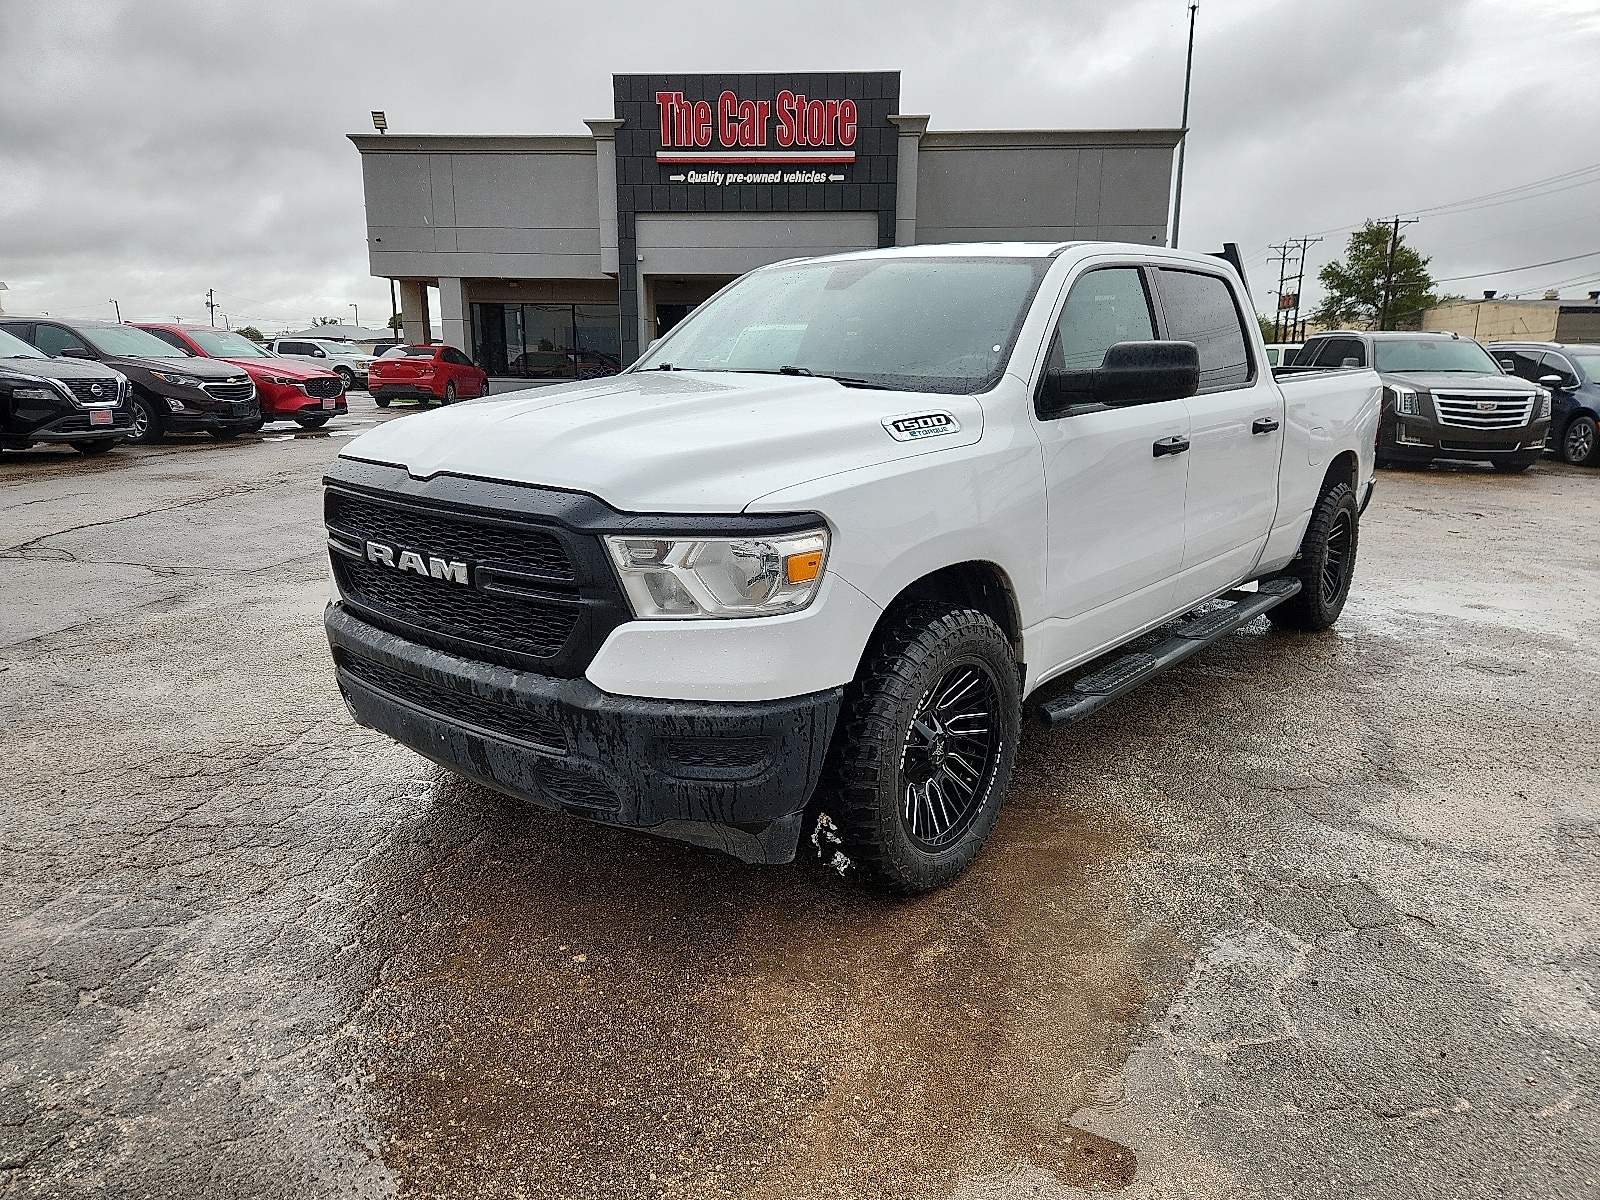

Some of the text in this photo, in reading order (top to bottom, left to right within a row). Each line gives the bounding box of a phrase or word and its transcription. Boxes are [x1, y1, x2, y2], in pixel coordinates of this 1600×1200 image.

[656, 89, 858, 147] The Car Store
[687, 170, 827, 186] Quality pre-owned vehicles
[894, 415, 947, 432] 1500
[366, 540, 469, 586] RAM
